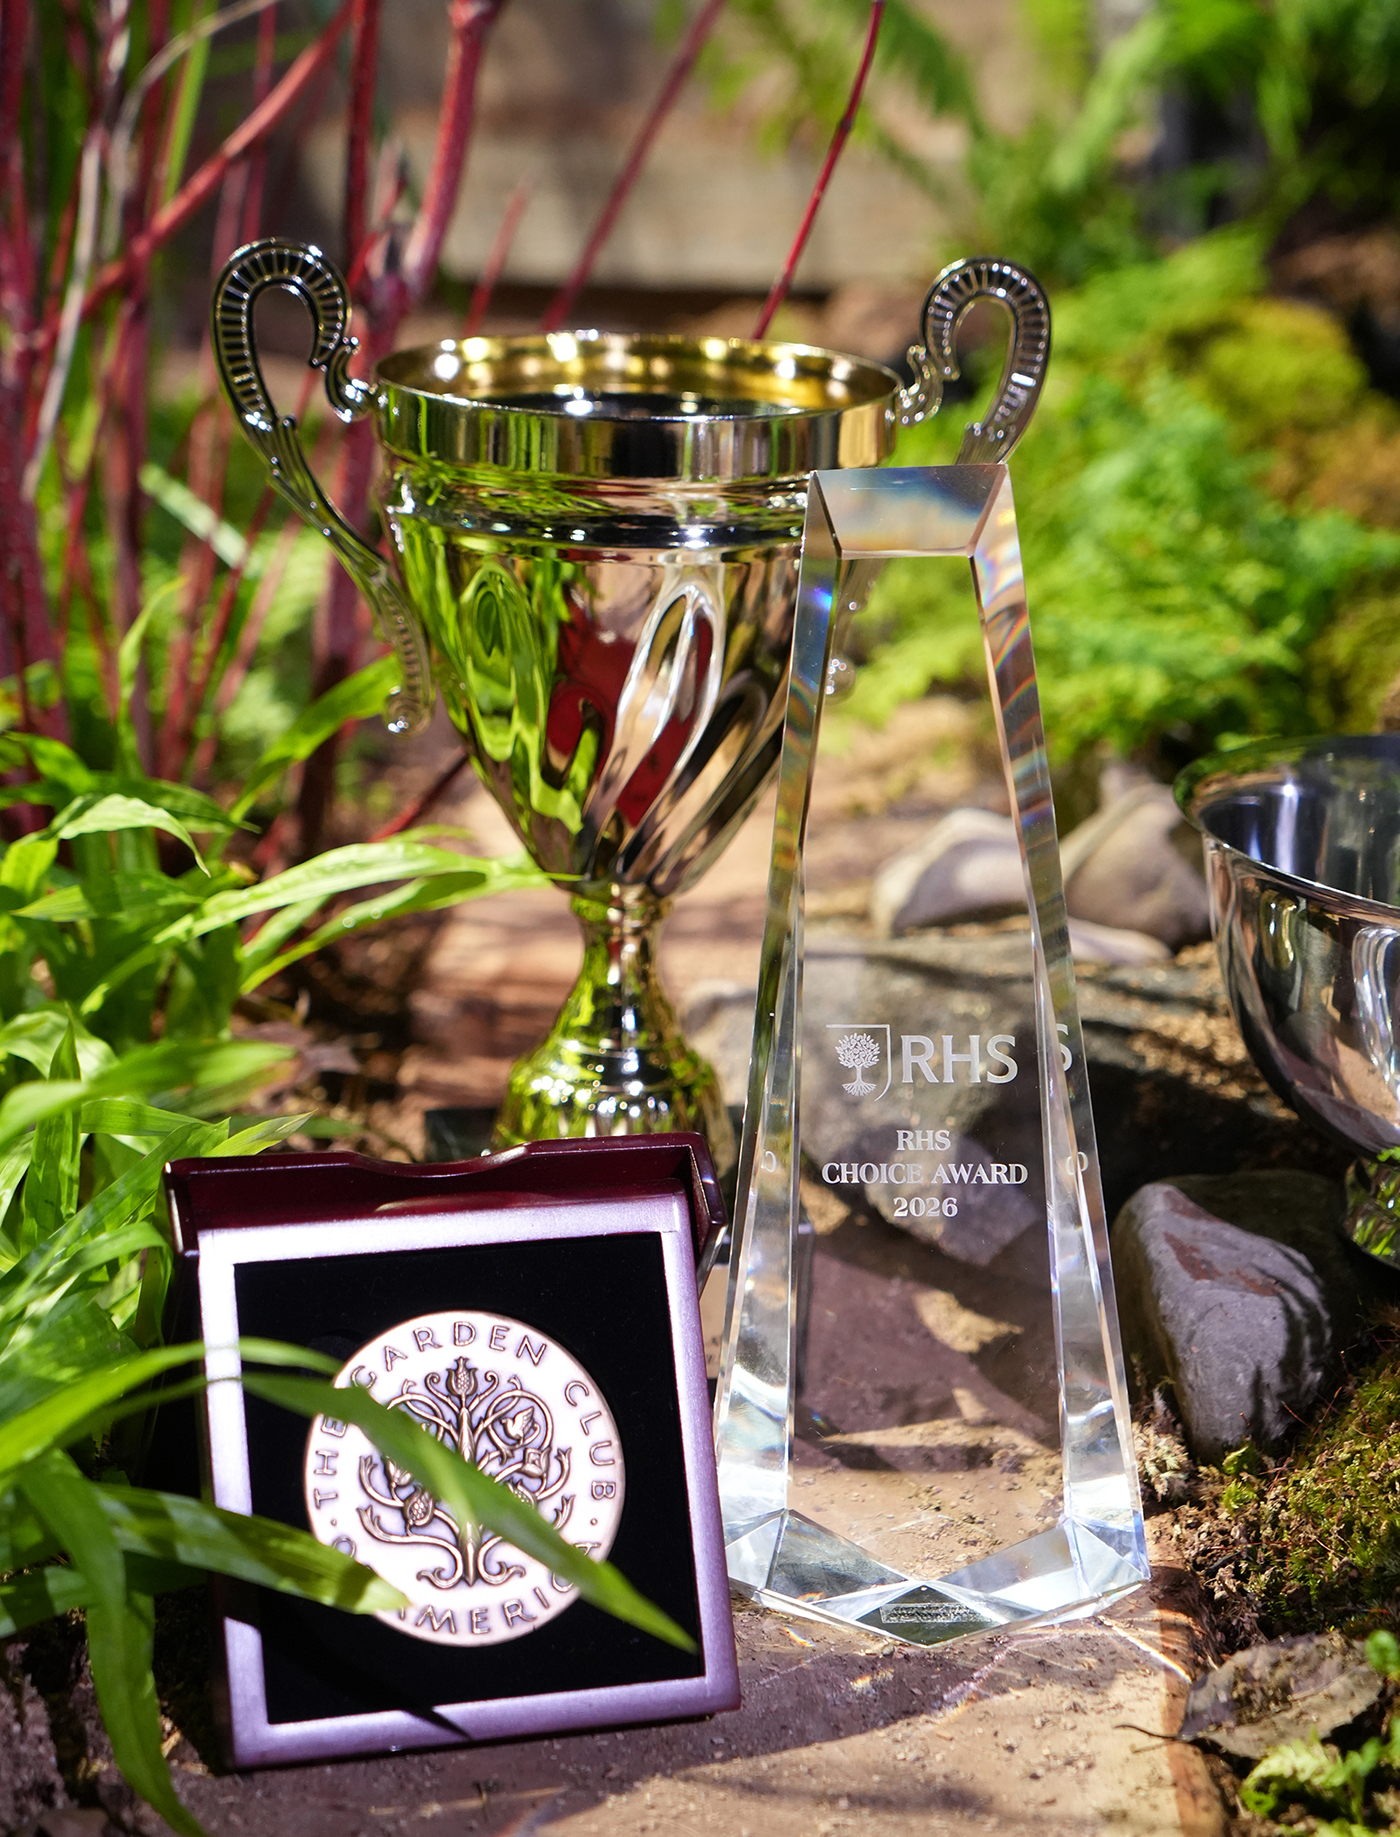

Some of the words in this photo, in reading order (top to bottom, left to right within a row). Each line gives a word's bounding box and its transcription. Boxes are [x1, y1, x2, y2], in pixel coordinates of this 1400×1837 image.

[901, 1034, 1018, 1083] RHS
[896, 1129, 951, 1151] RHS
[821, 1162, 923, 1184] CHOICE
[931, 1162, 1028, 1184] AWARD
[893, 1197, 958, 1218] 2026
[313, 1416, 348, 1509] THE
[564, 1380, 617, 1501] CLUB
